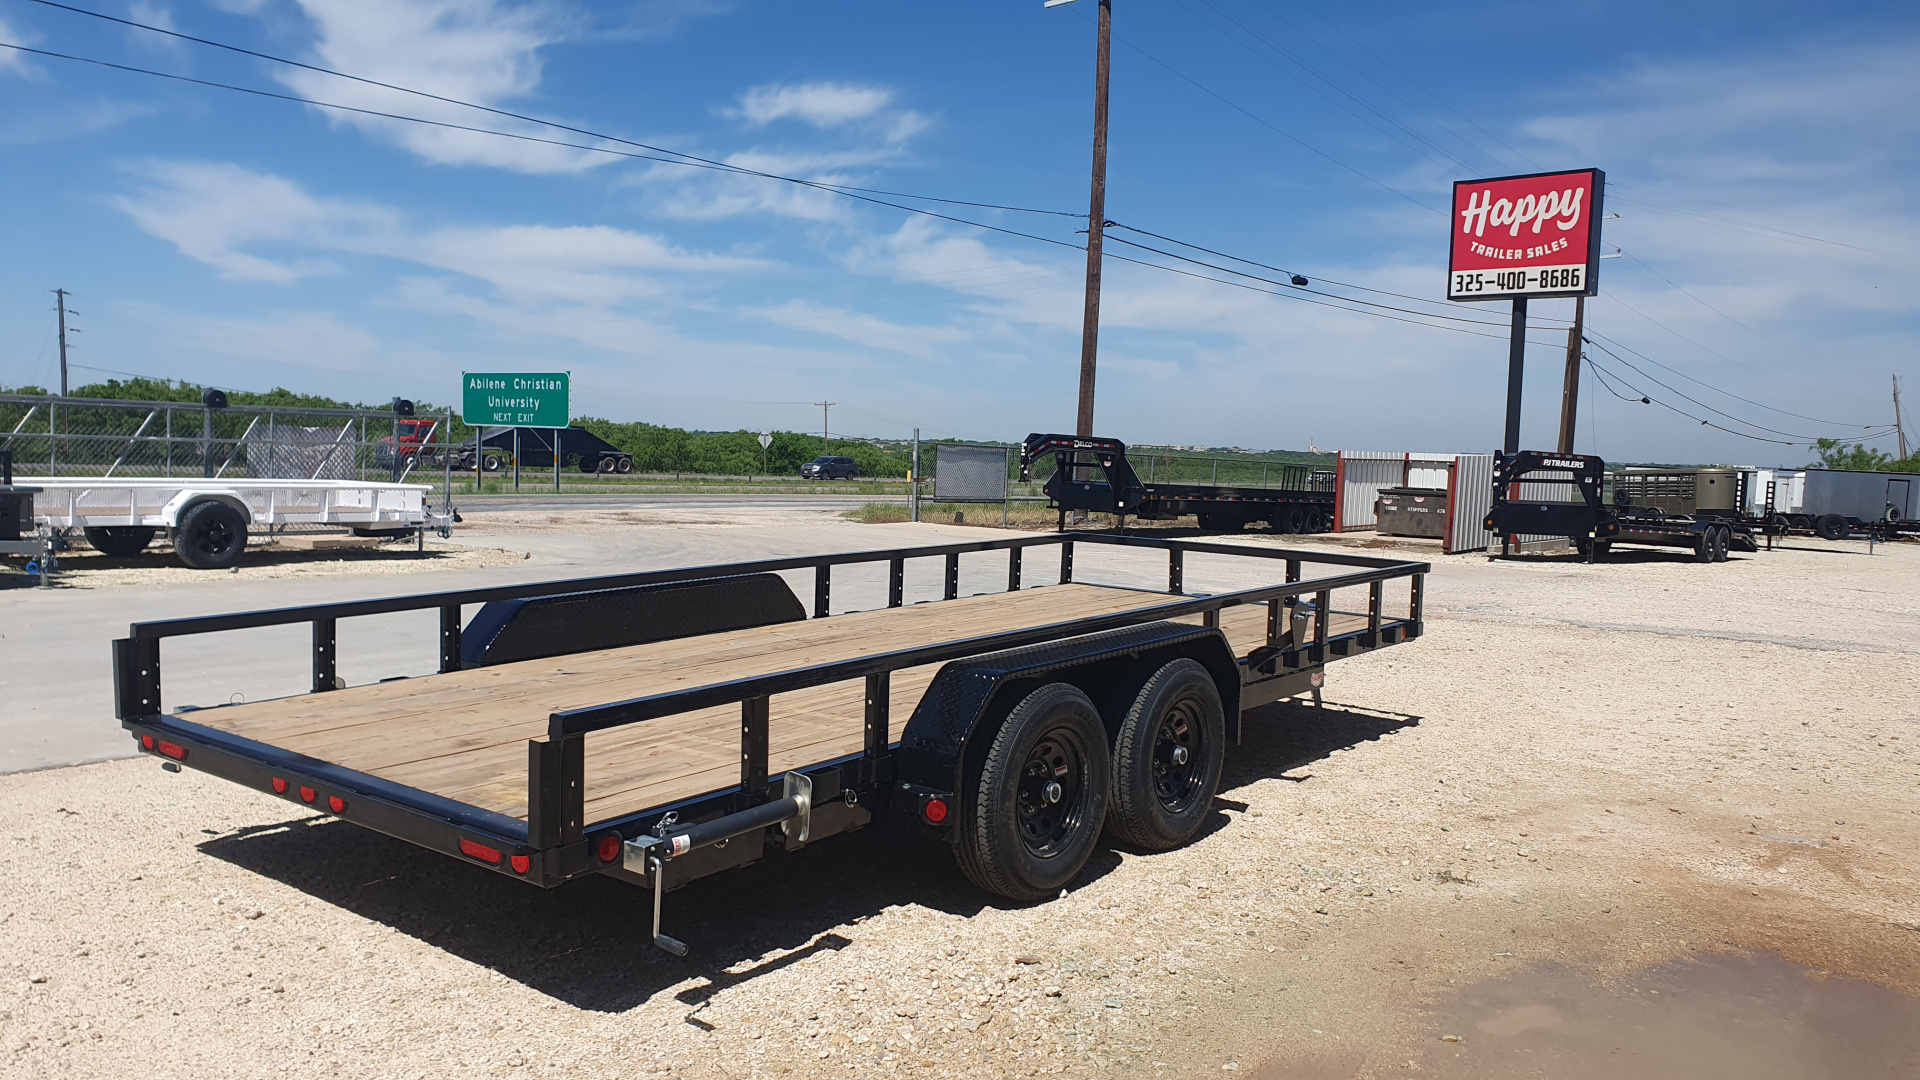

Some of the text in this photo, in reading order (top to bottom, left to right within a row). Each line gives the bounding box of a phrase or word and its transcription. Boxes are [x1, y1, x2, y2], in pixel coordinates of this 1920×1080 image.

[1461, 187, 1584, 237] Happy
[1470, 237, 1568, 260] TRAILER SALES
[1455, 268, 1580, 293] 325-400-8686
[470, 378, 562, 390] Abilene Christian
[488, 396, 540, 411] University
[493, 412, 534, 422] NEXT EXIT
[1552, 460, 1584, 468] TRAILERS
